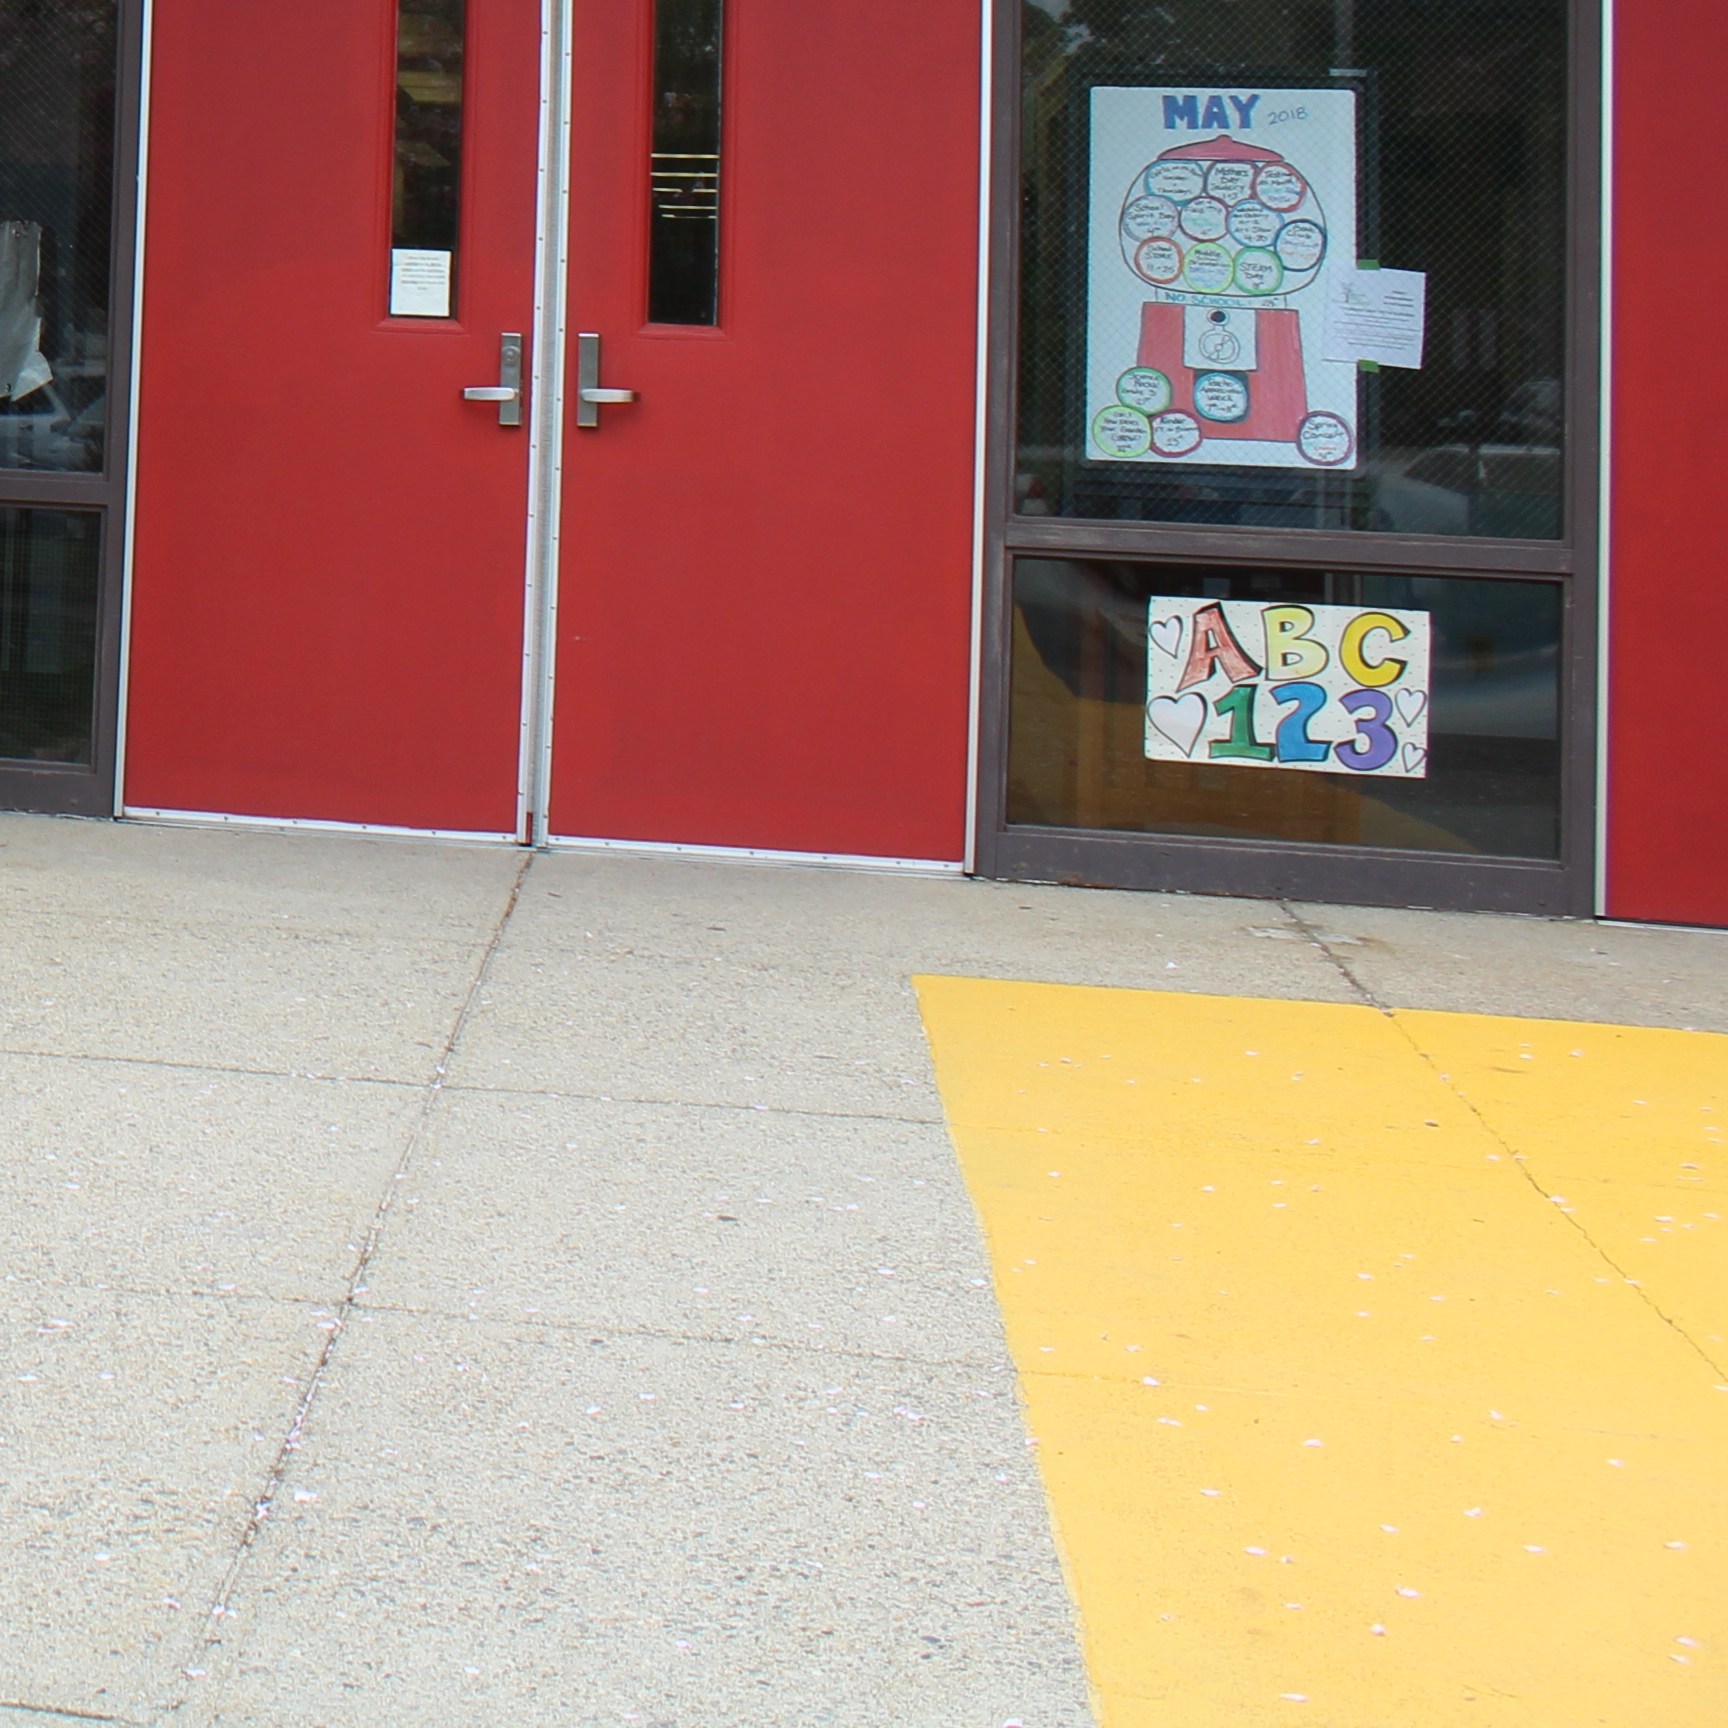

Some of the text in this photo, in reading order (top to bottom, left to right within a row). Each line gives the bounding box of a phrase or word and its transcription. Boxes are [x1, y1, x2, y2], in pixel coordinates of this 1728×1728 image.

[1162, 94, 1309, 129] MAY 2018
[1165, 291, 1186, 303] NO
[1176, 601, 1411, 693] ABC
[1207, 682, 1398, 771] 123
